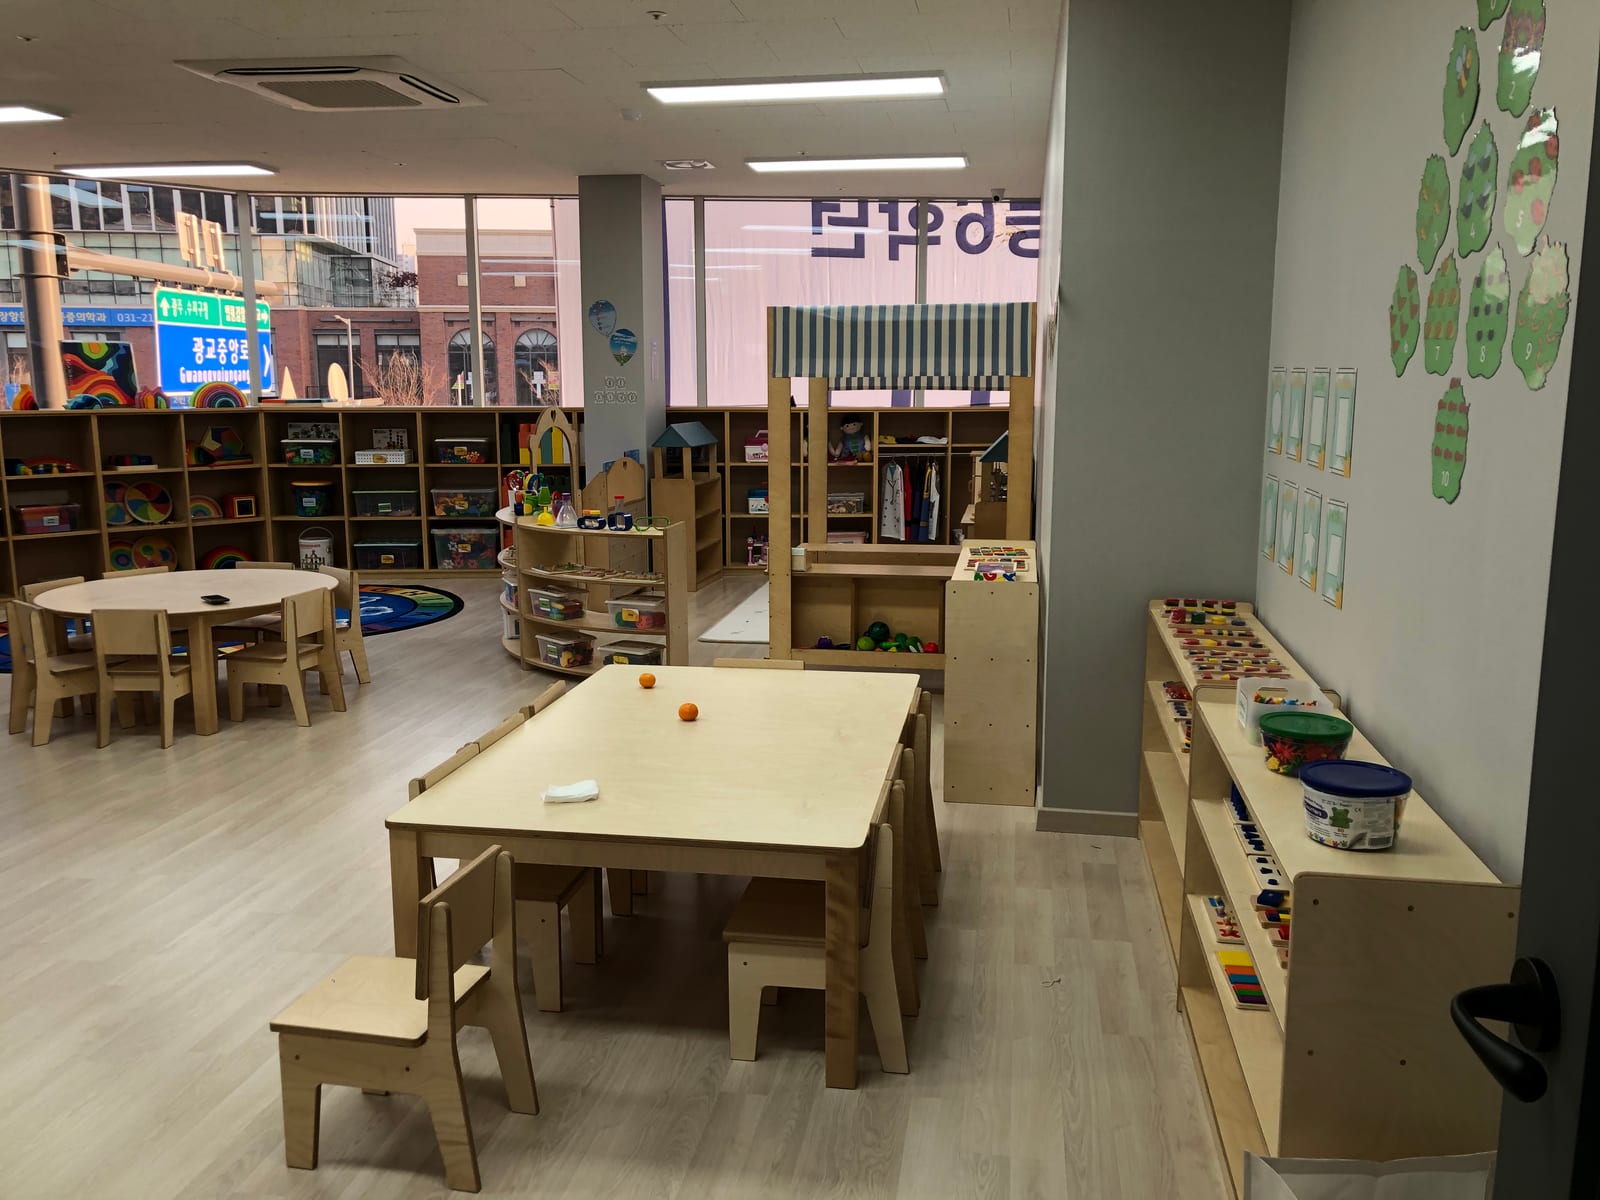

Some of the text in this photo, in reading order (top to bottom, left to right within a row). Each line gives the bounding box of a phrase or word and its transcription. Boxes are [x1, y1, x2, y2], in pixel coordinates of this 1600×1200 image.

[1516, 210, 1524, 228] 5
[1479, 346, 1486, 363] 8
[1525, 343, 1533, 360] 9
[1441, 470, 1450, 487] 10
